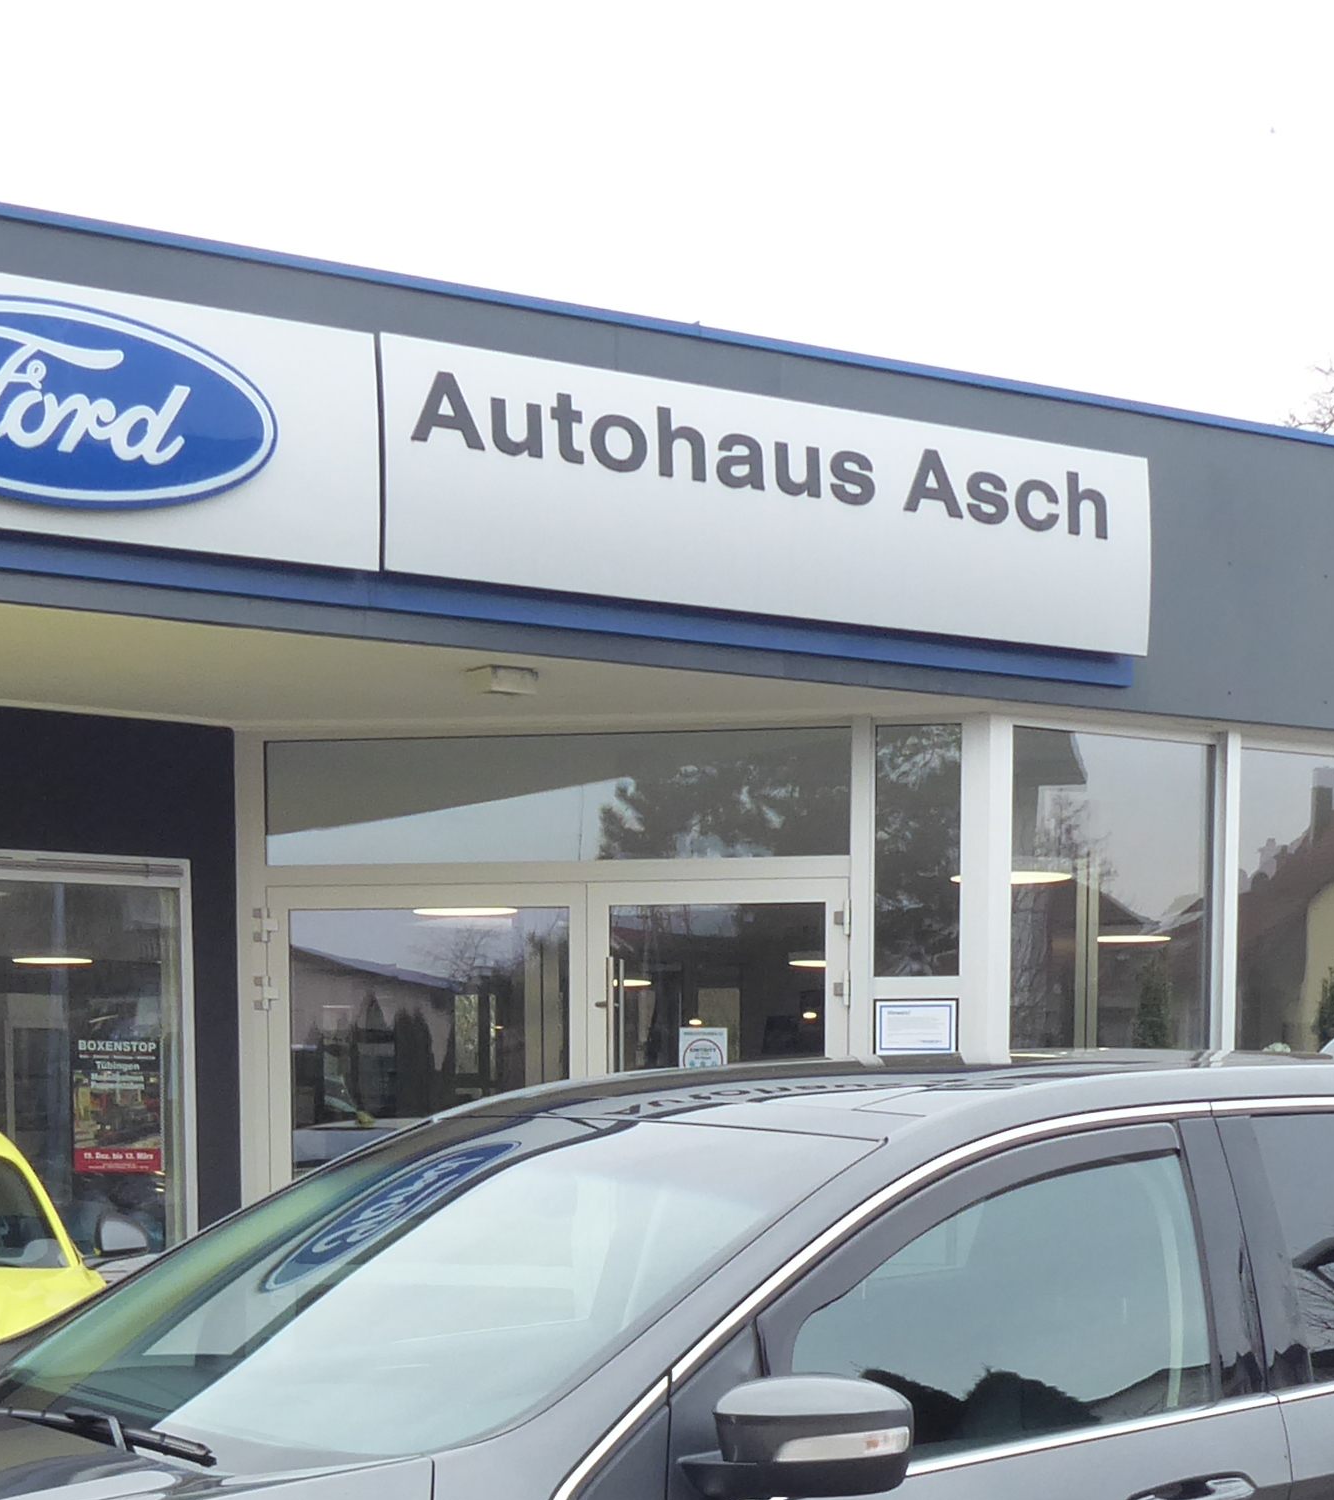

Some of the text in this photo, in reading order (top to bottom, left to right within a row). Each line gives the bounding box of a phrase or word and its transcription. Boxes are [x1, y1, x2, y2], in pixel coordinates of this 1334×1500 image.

[410, 371, 1109, 541] Autohaus Asch
[78, 1040, 157, 1053] BOXENSTOP
[95, 1061, 140, 1071] Tübingen
